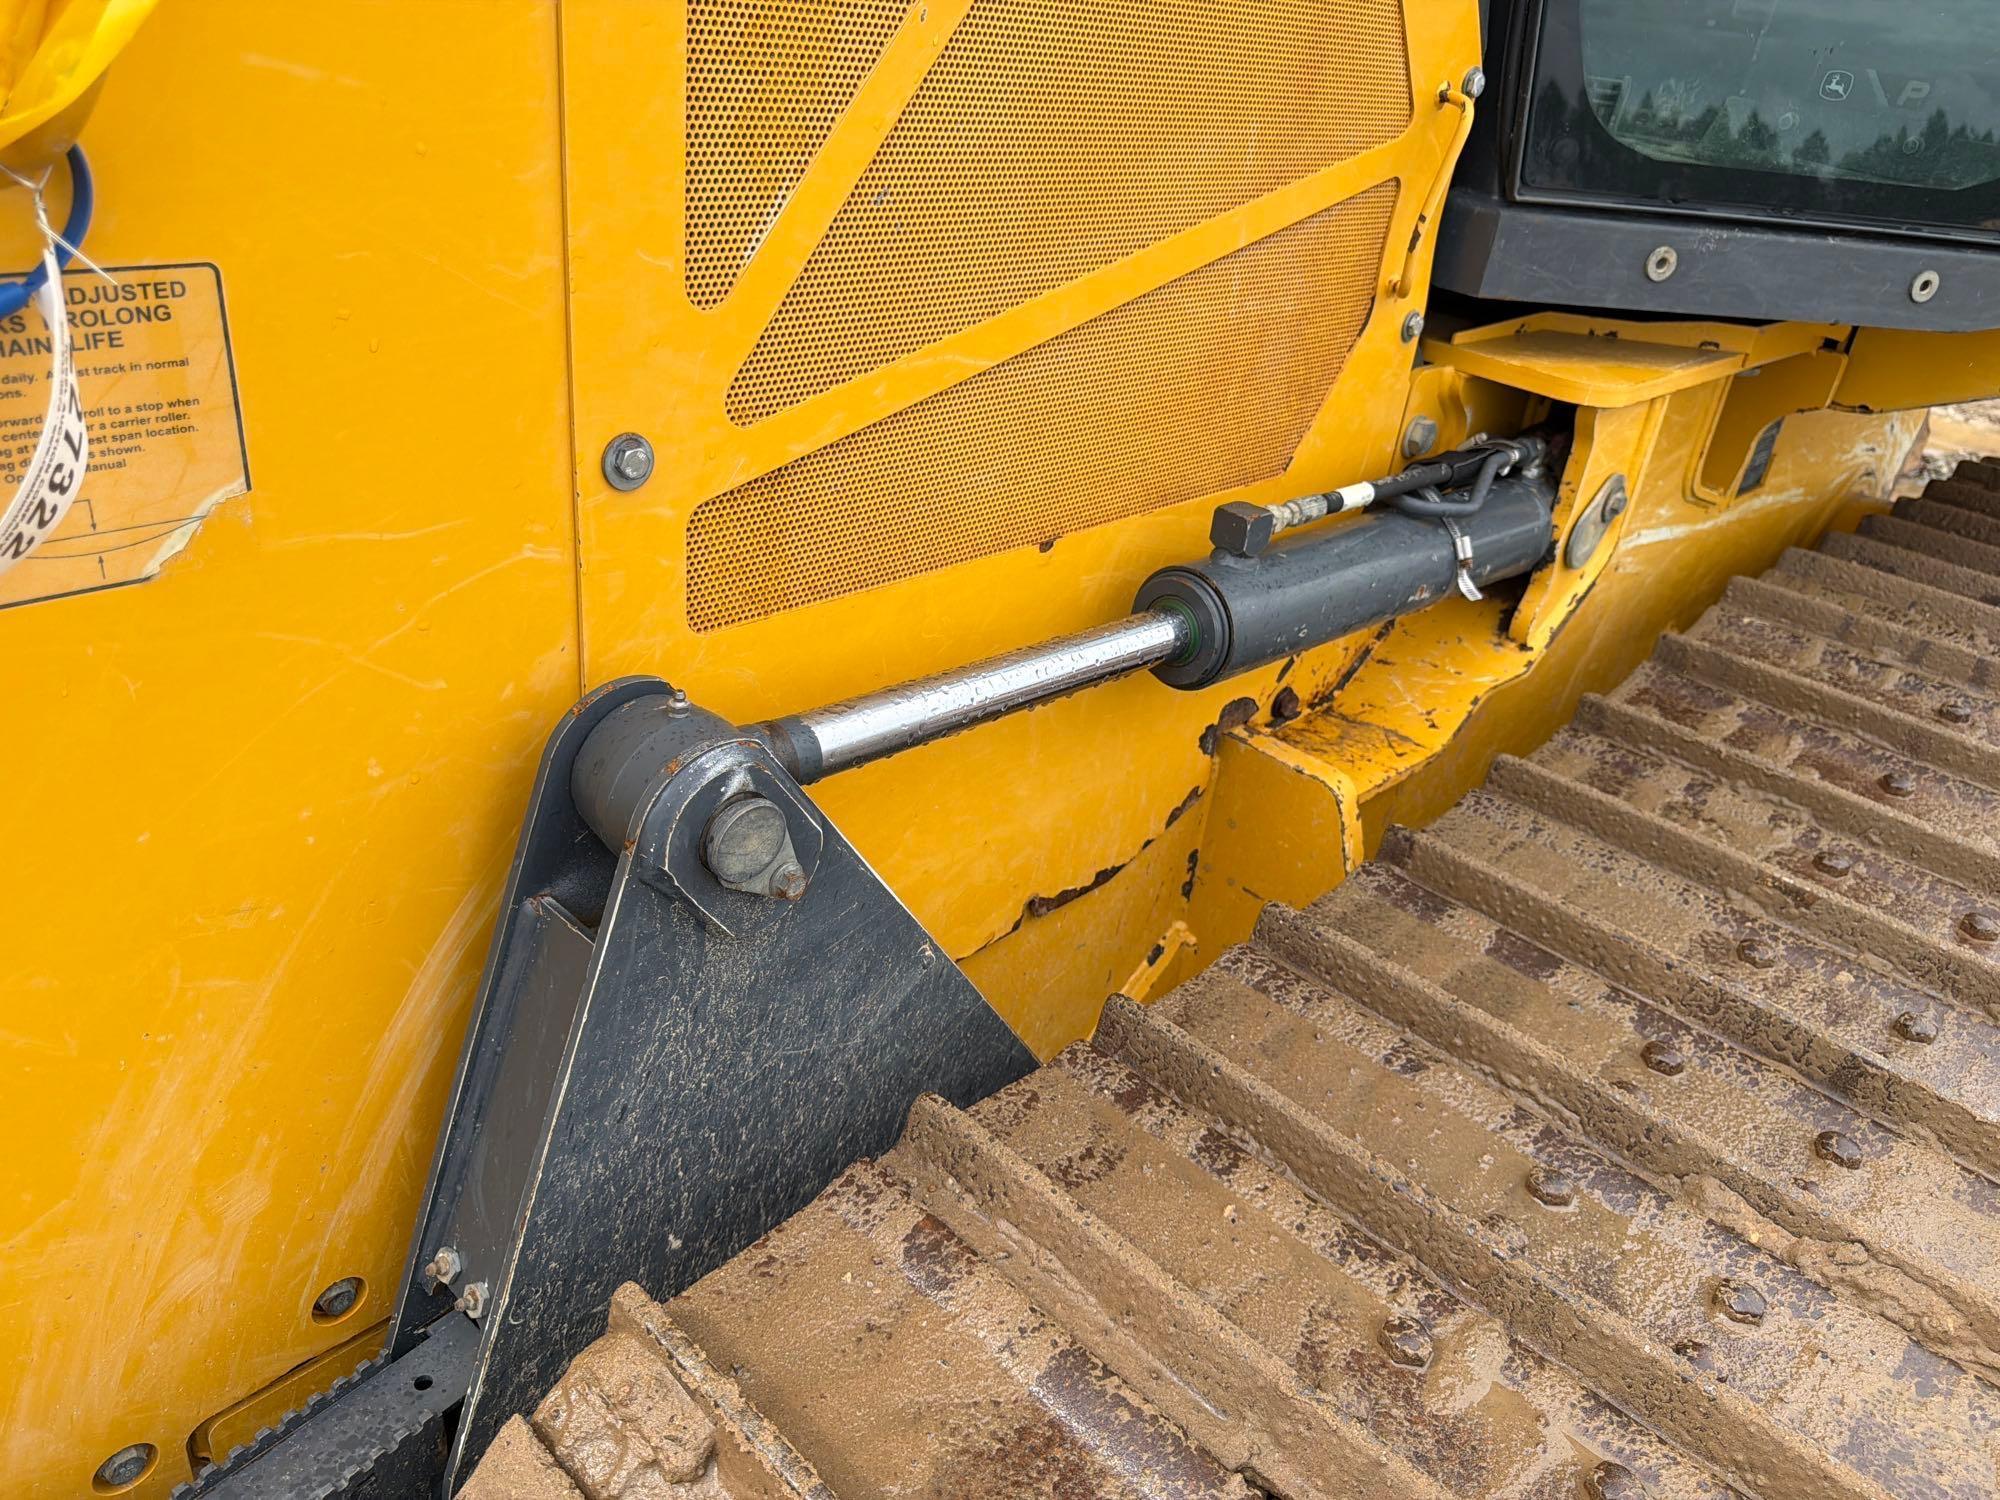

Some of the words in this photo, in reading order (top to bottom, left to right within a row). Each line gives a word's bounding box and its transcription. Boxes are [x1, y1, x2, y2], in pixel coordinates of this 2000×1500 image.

[64, 281, 186, 306] DJUSTED
[42, 304, 172, 331] ROLONG
[0, 336, 52, 357] AIN
[70, 330, 124, 352] LIFE
[1, 372, 38, 384] daily.
[93, 363, 126, 376] track
[130, 361, 142, 372] in
[146, 357, 190, 370] normal
[107, 406, 121, 416] to
[125, 406, 132, 414] a
[136, 401, 164, 413] stop
[166, 398, 200, 409] when
[99, 422, 107, 430] a
[110, 416, 152, 429] carrier
[155, 411, 191, 424] roller.
[16, 445, 30, 455] at
[111, 430, 142, 444] span
[146, 424, 199, 438] location.
[99, 443, 146, 458] shown.
